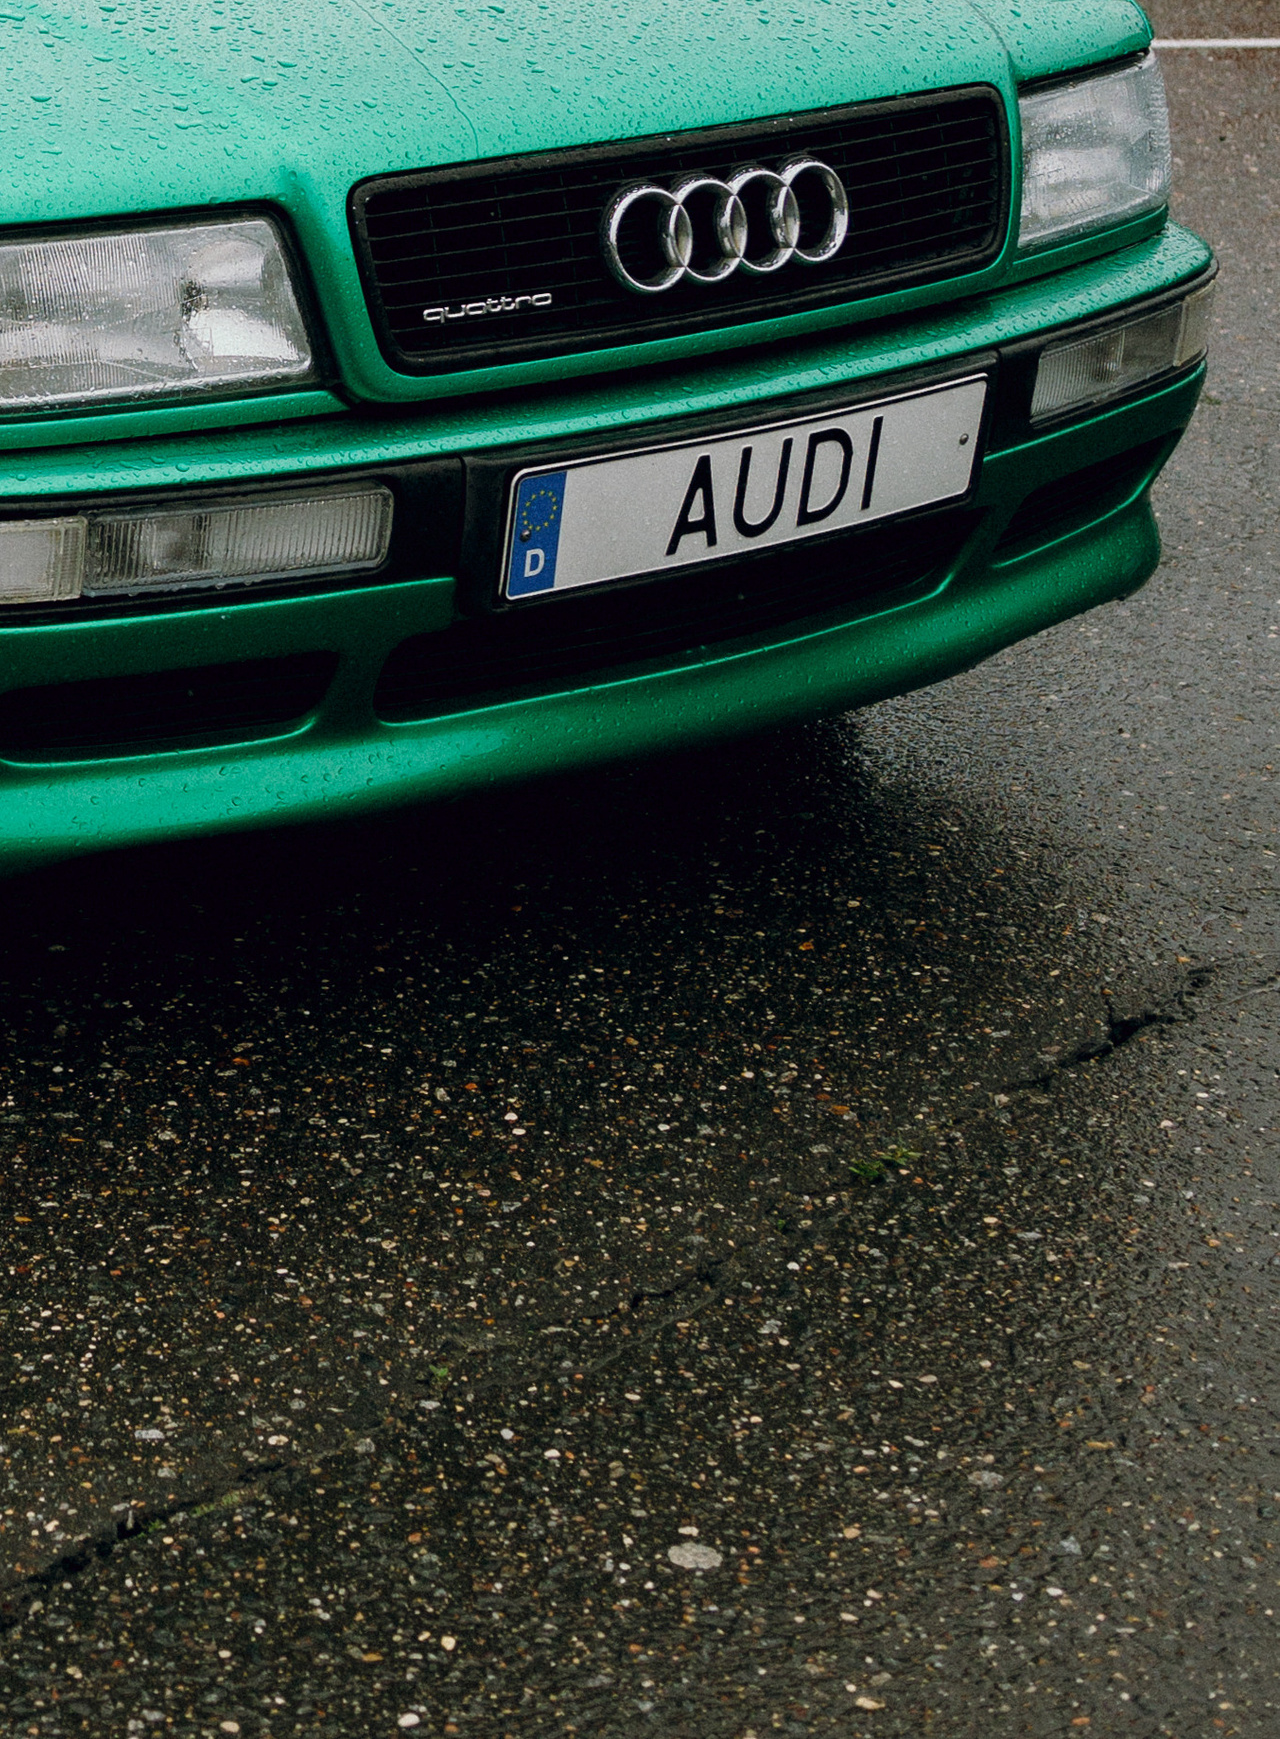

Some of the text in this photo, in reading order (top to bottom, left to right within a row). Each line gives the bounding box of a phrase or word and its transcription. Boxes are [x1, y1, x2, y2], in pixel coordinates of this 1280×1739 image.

[422, 292, 553, 323] quattro
[524, 416, 884, 578] D AUDI
